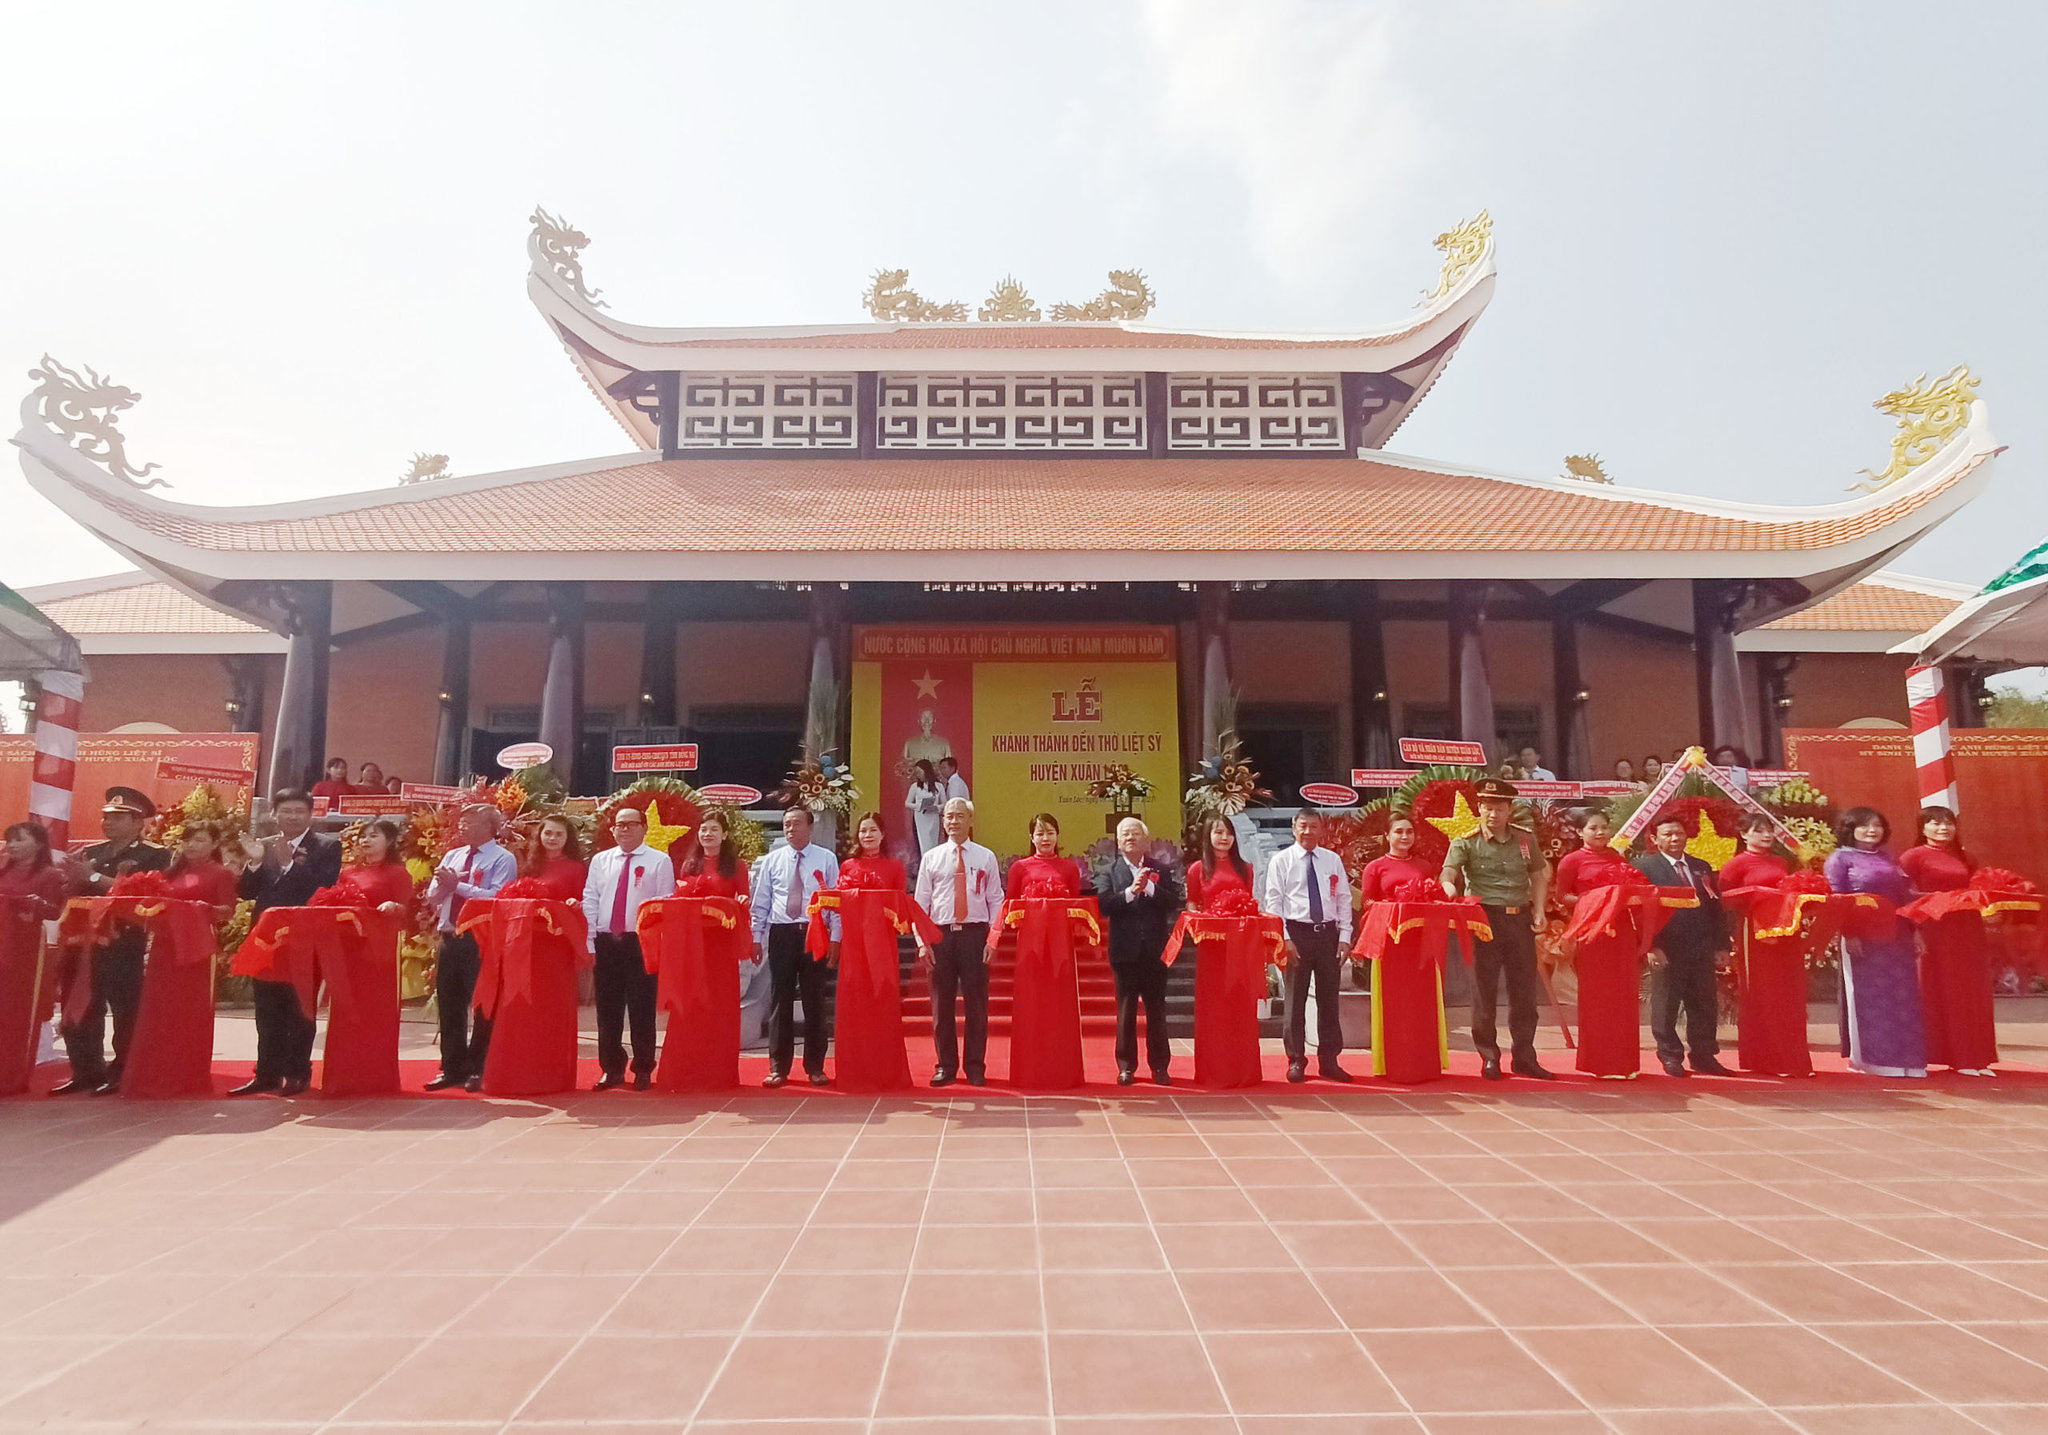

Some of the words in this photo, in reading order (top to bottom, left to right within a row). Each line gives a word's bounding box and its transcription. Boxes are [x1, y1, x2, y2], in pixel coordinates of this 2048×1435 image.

[864, 633, 893, 654] NƯỚC
[896, 634, 925, 657] CỘNG
[953, 633, 968, 654] XÃ
[970, 633, 988, 657] HỘI
[991, 632, 1013, 655] CHỦ
[1015, 634, 1048, 655] NGHĨA
[1051, 634, 1073, 657] VIỆT
[1076, 637, 1101, 654] NAM
[1104, 633, 1136, 654] MUÔN
[1139, 634, 1164, 654] NĂM
[1051, 676, 1103, 723] LỄ
[992, 731, 1030, 753] KHÁNH
[1032, 731, 1069, 753] THÀNH
[1098, 731, 1119, 752] THỜ
[1121, 731, 1145, 756] LIỆT
[1030, 760, 1067, 785] HUYỆN
[1070, 760, 1101, 781] XUÂN
